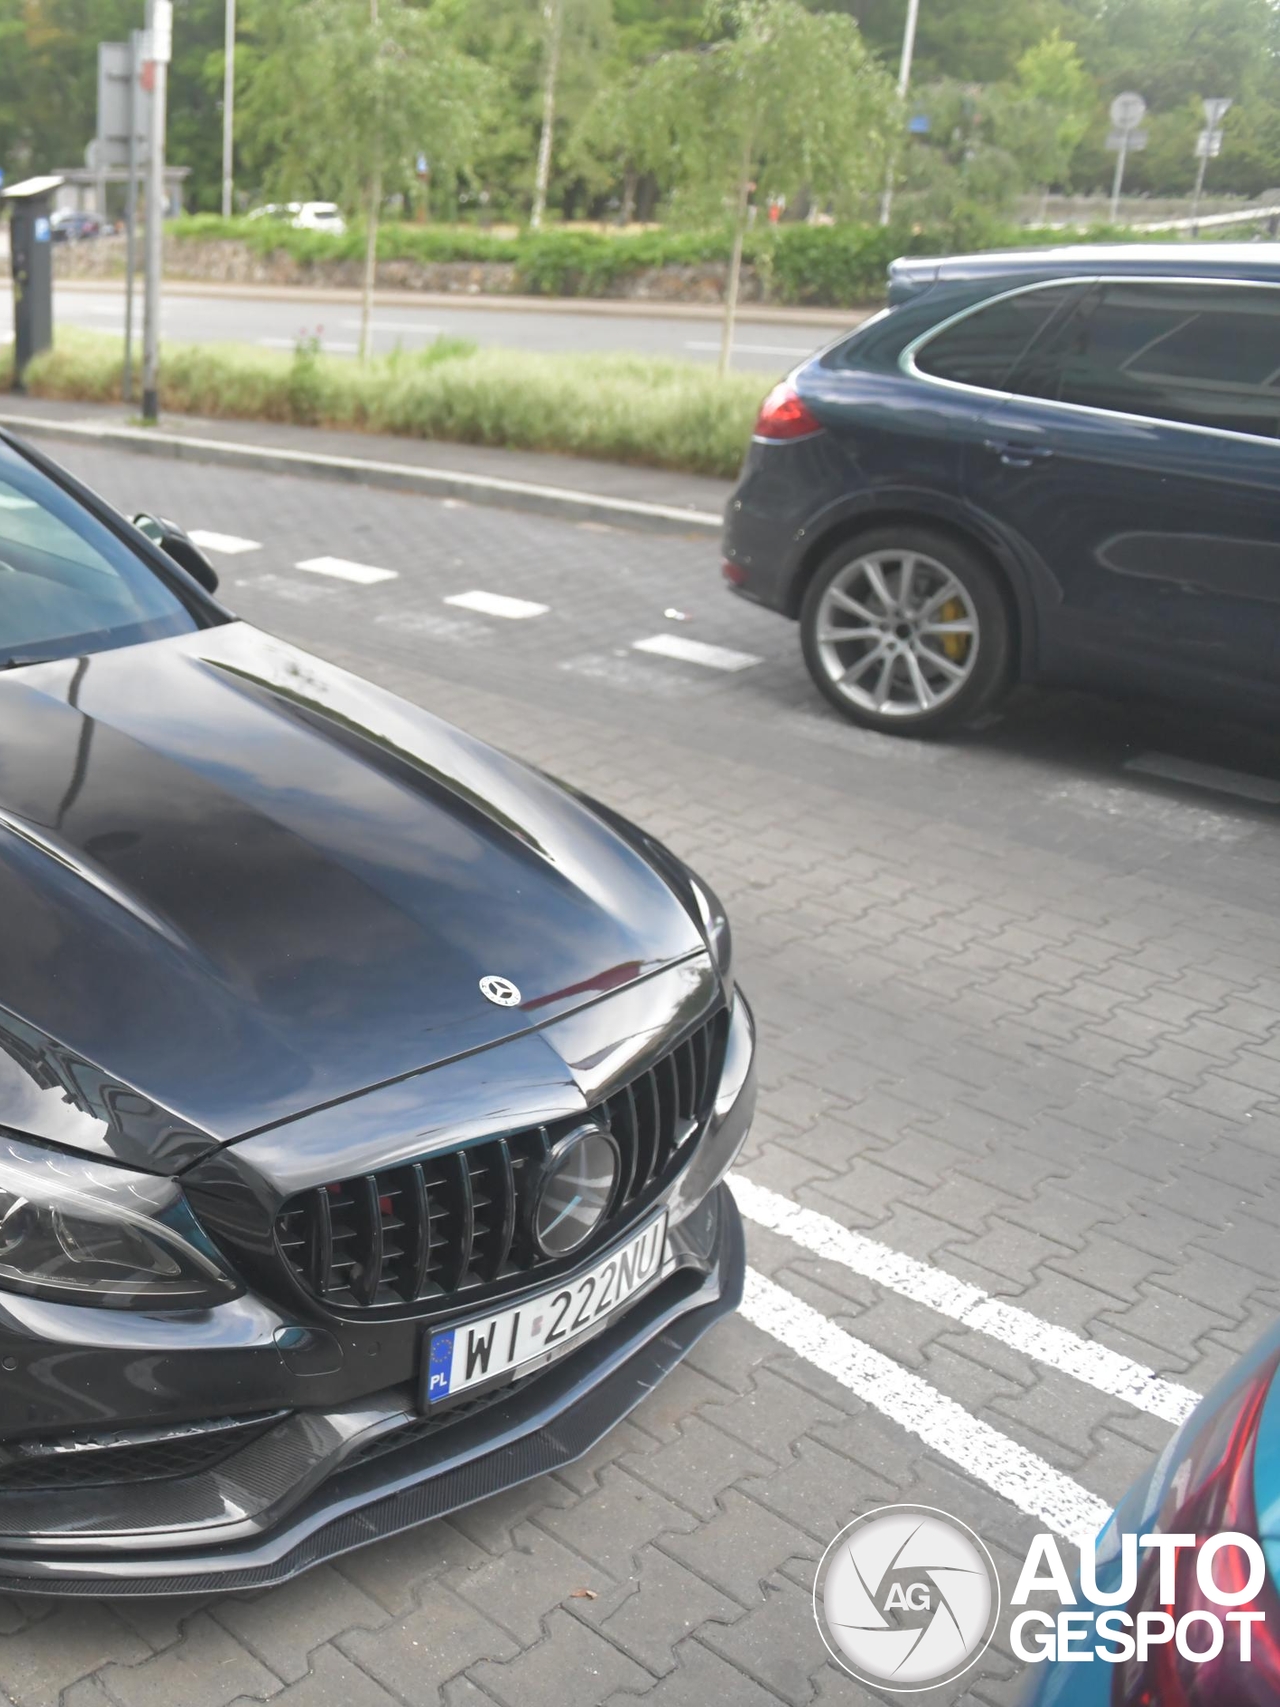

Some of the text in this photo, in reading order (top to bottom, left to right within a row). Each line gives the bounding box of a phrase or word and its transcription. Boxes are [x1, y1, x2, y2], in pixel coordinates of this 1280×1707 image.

[465, 1224, 659, 1381] WI 222NU
[430, 1374, 447, 1391] PL
